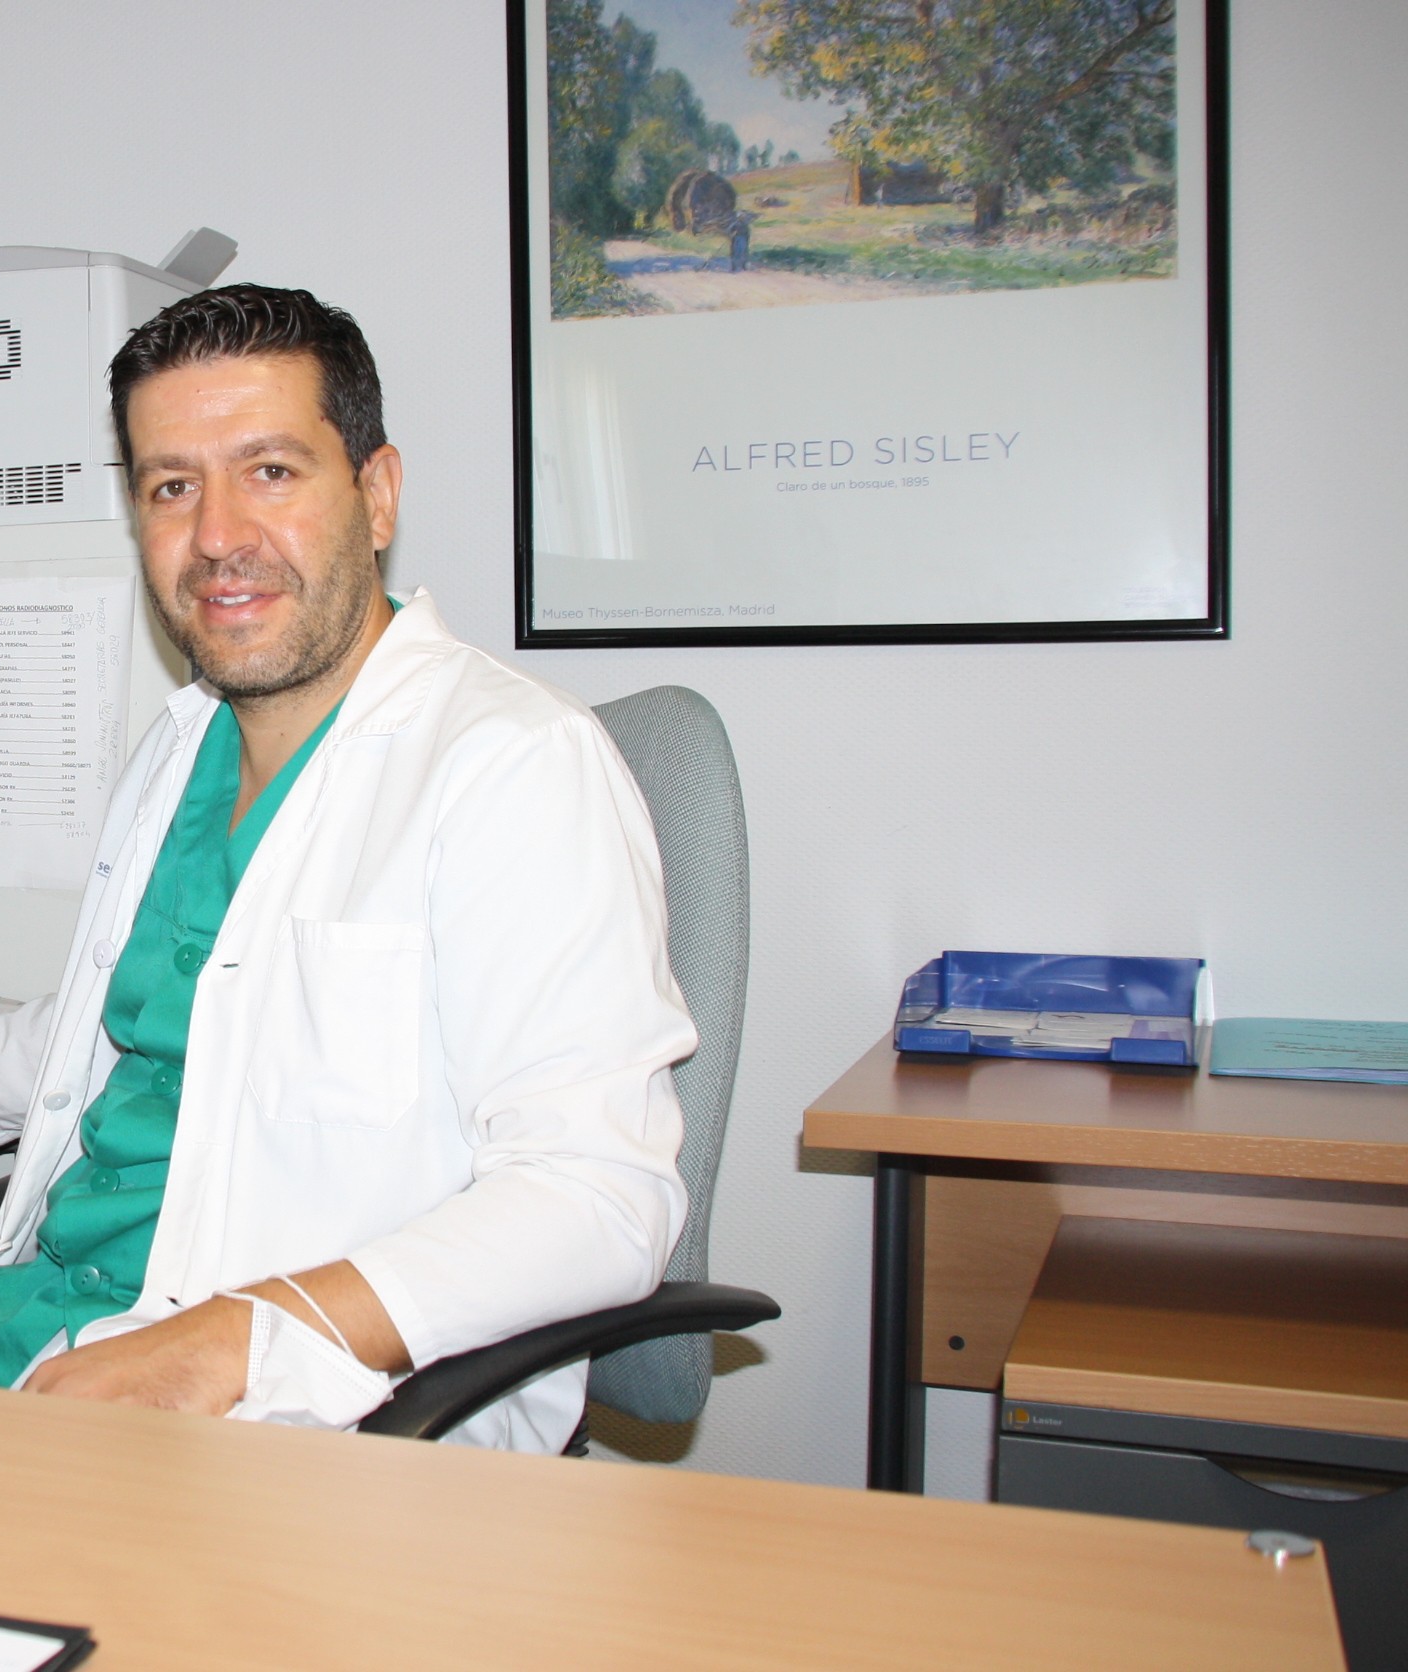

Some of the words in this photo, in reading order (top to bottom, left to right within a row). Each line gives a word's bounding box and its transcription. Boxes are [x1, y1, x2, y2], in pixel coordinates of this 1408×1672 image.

[692, 439, 854, 472] ALFRED
[874, 431, 1020, 465] SISLEY
[776, 481, 808, 492] Claro
[811, 480, 827, 491] de
[830, 482, 845, 490] un
[849, 478, 898, 491] bosque,
[902, 476, 930, 488] 1895
[542, 608, 583, 619] Museo
[588, 605, 724, 620] Thyssen-Bornemisza,
[729, 604, 776, 616] Madrid
